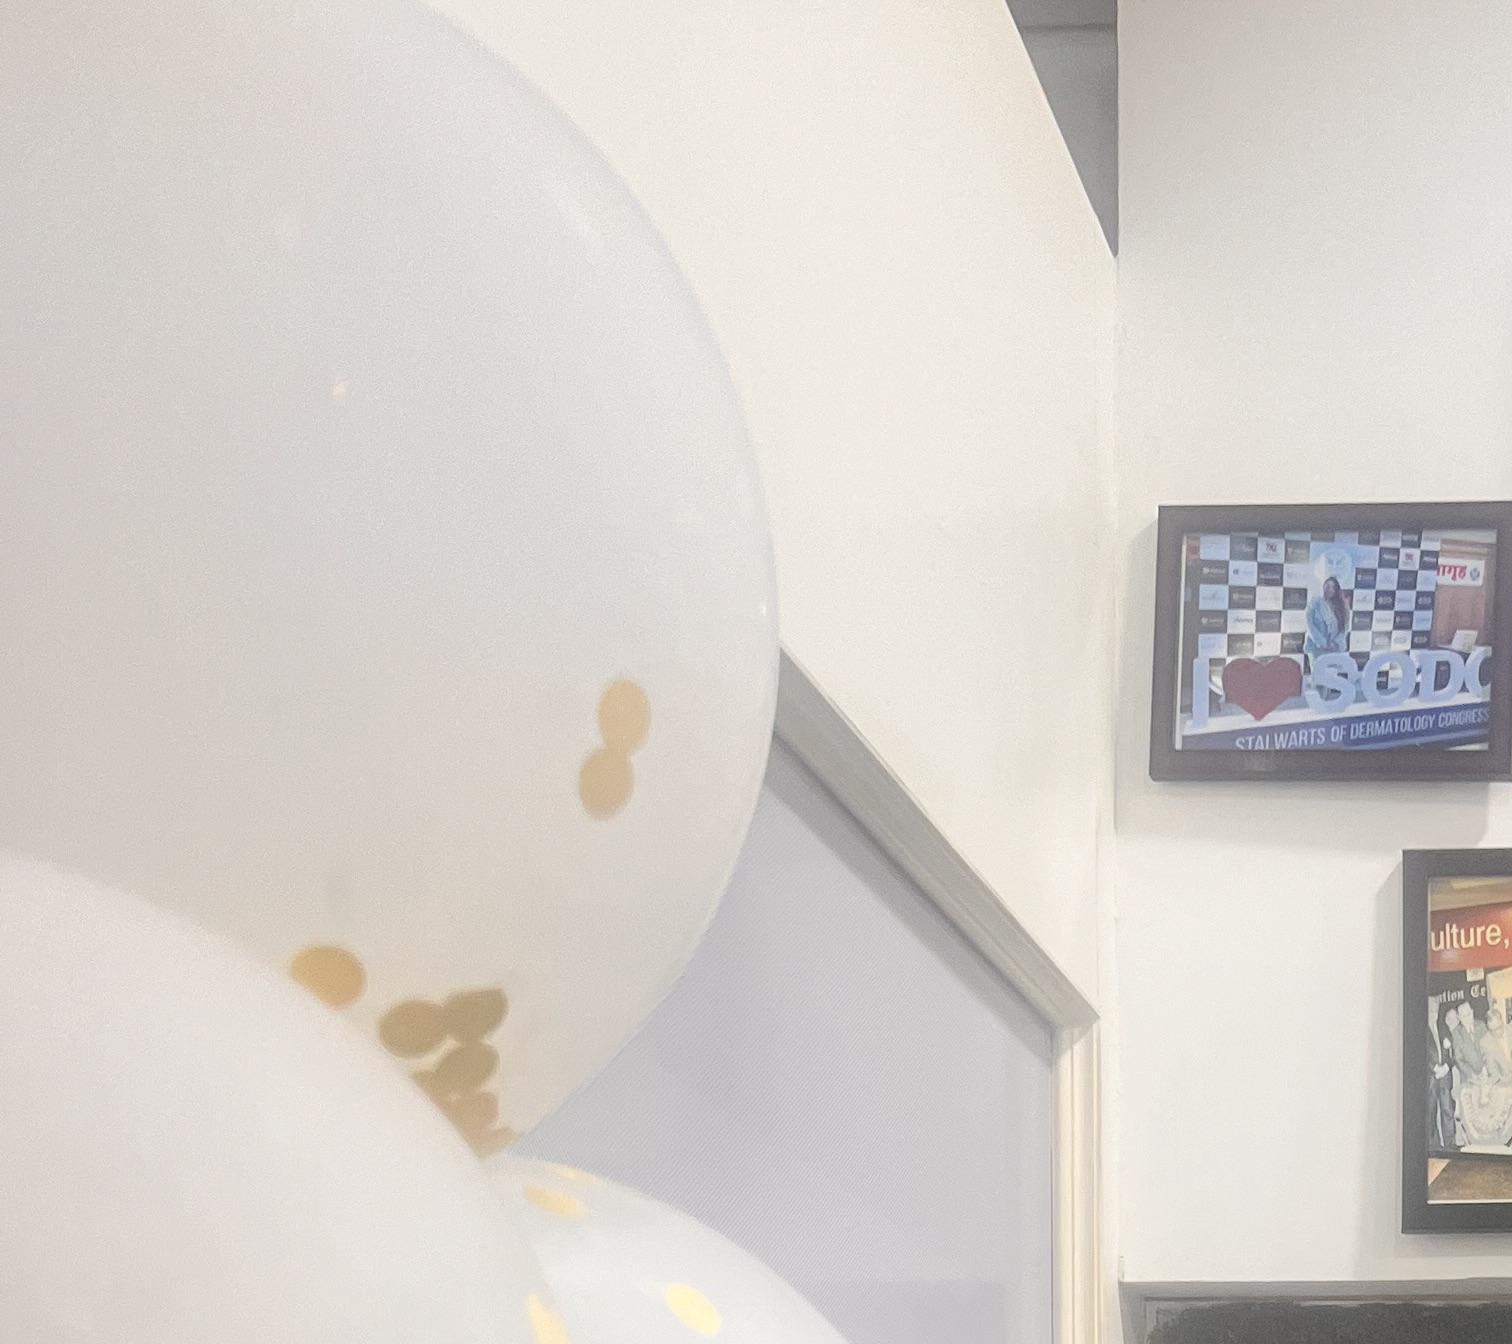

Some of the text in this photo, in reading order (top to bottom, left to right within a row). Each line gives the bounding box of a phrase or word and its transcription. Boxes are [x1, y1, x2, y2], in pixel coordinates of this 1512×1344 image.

[1331, 724, 1348, 742] OF
[1351, 714, 1436, 743] DERMATOLOGY
[1438, 708, 1489, 727] CONGRESS
